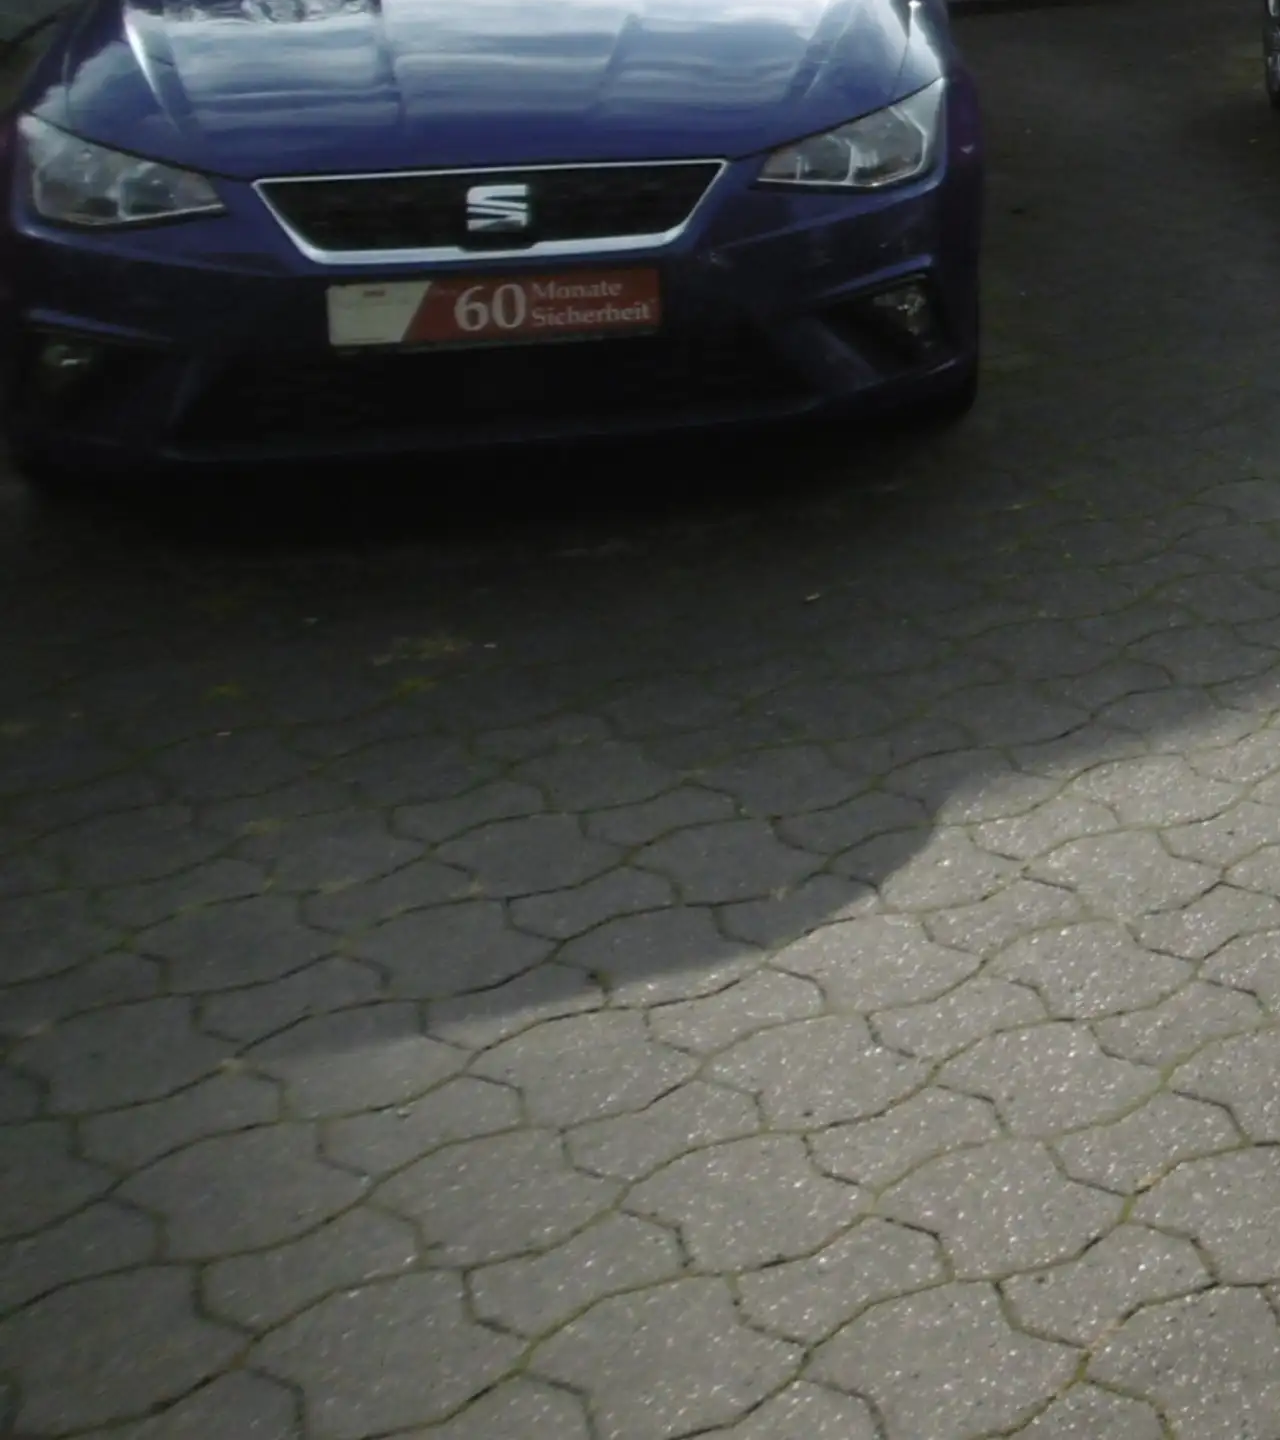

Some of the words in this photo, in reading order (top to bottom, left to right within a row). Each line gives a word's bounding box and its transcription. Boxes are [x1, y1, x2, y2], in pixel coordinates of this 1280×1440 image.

[531, 279, 624, 300] Monate
[453, 283, 527, 332] 60
[531, 300, 652, 328] Sicherheit
